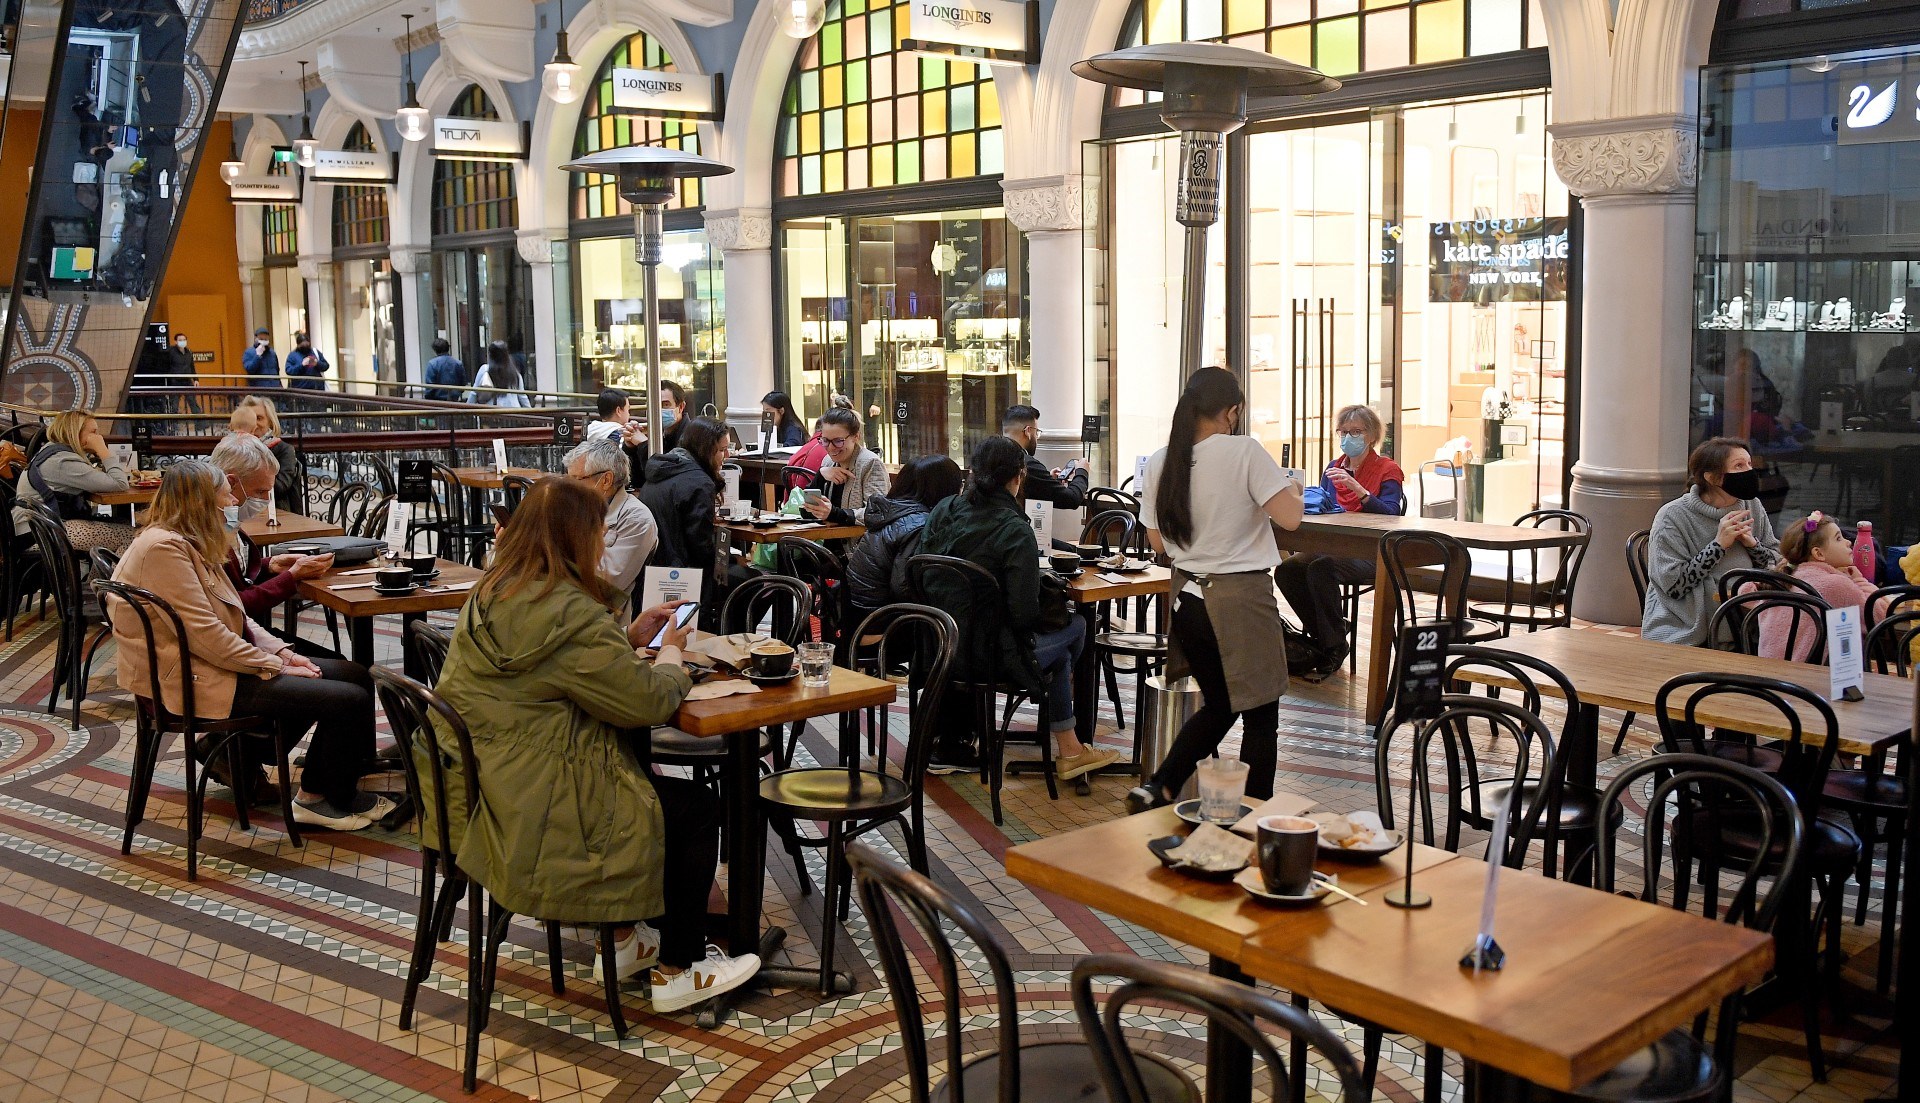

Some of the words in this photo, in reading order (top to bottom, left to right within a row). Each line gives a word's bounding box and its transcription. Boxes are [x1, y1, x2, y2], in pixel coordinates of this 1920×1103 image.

[923, 4, 991, 24] LONGINES
[622, 78, 682, 92] LONGINES
[441, 128, 481, 140] TUMI
[1443, 240, 1491, 262] kate
[1498, 235, 1569, 267] spade
[1469, 272, 1500, 284] NEW
[1503, 272, 1541, 284] YORK
[411, 462, 419, 471] 7
[1416, 631, 1439, 651] 22
